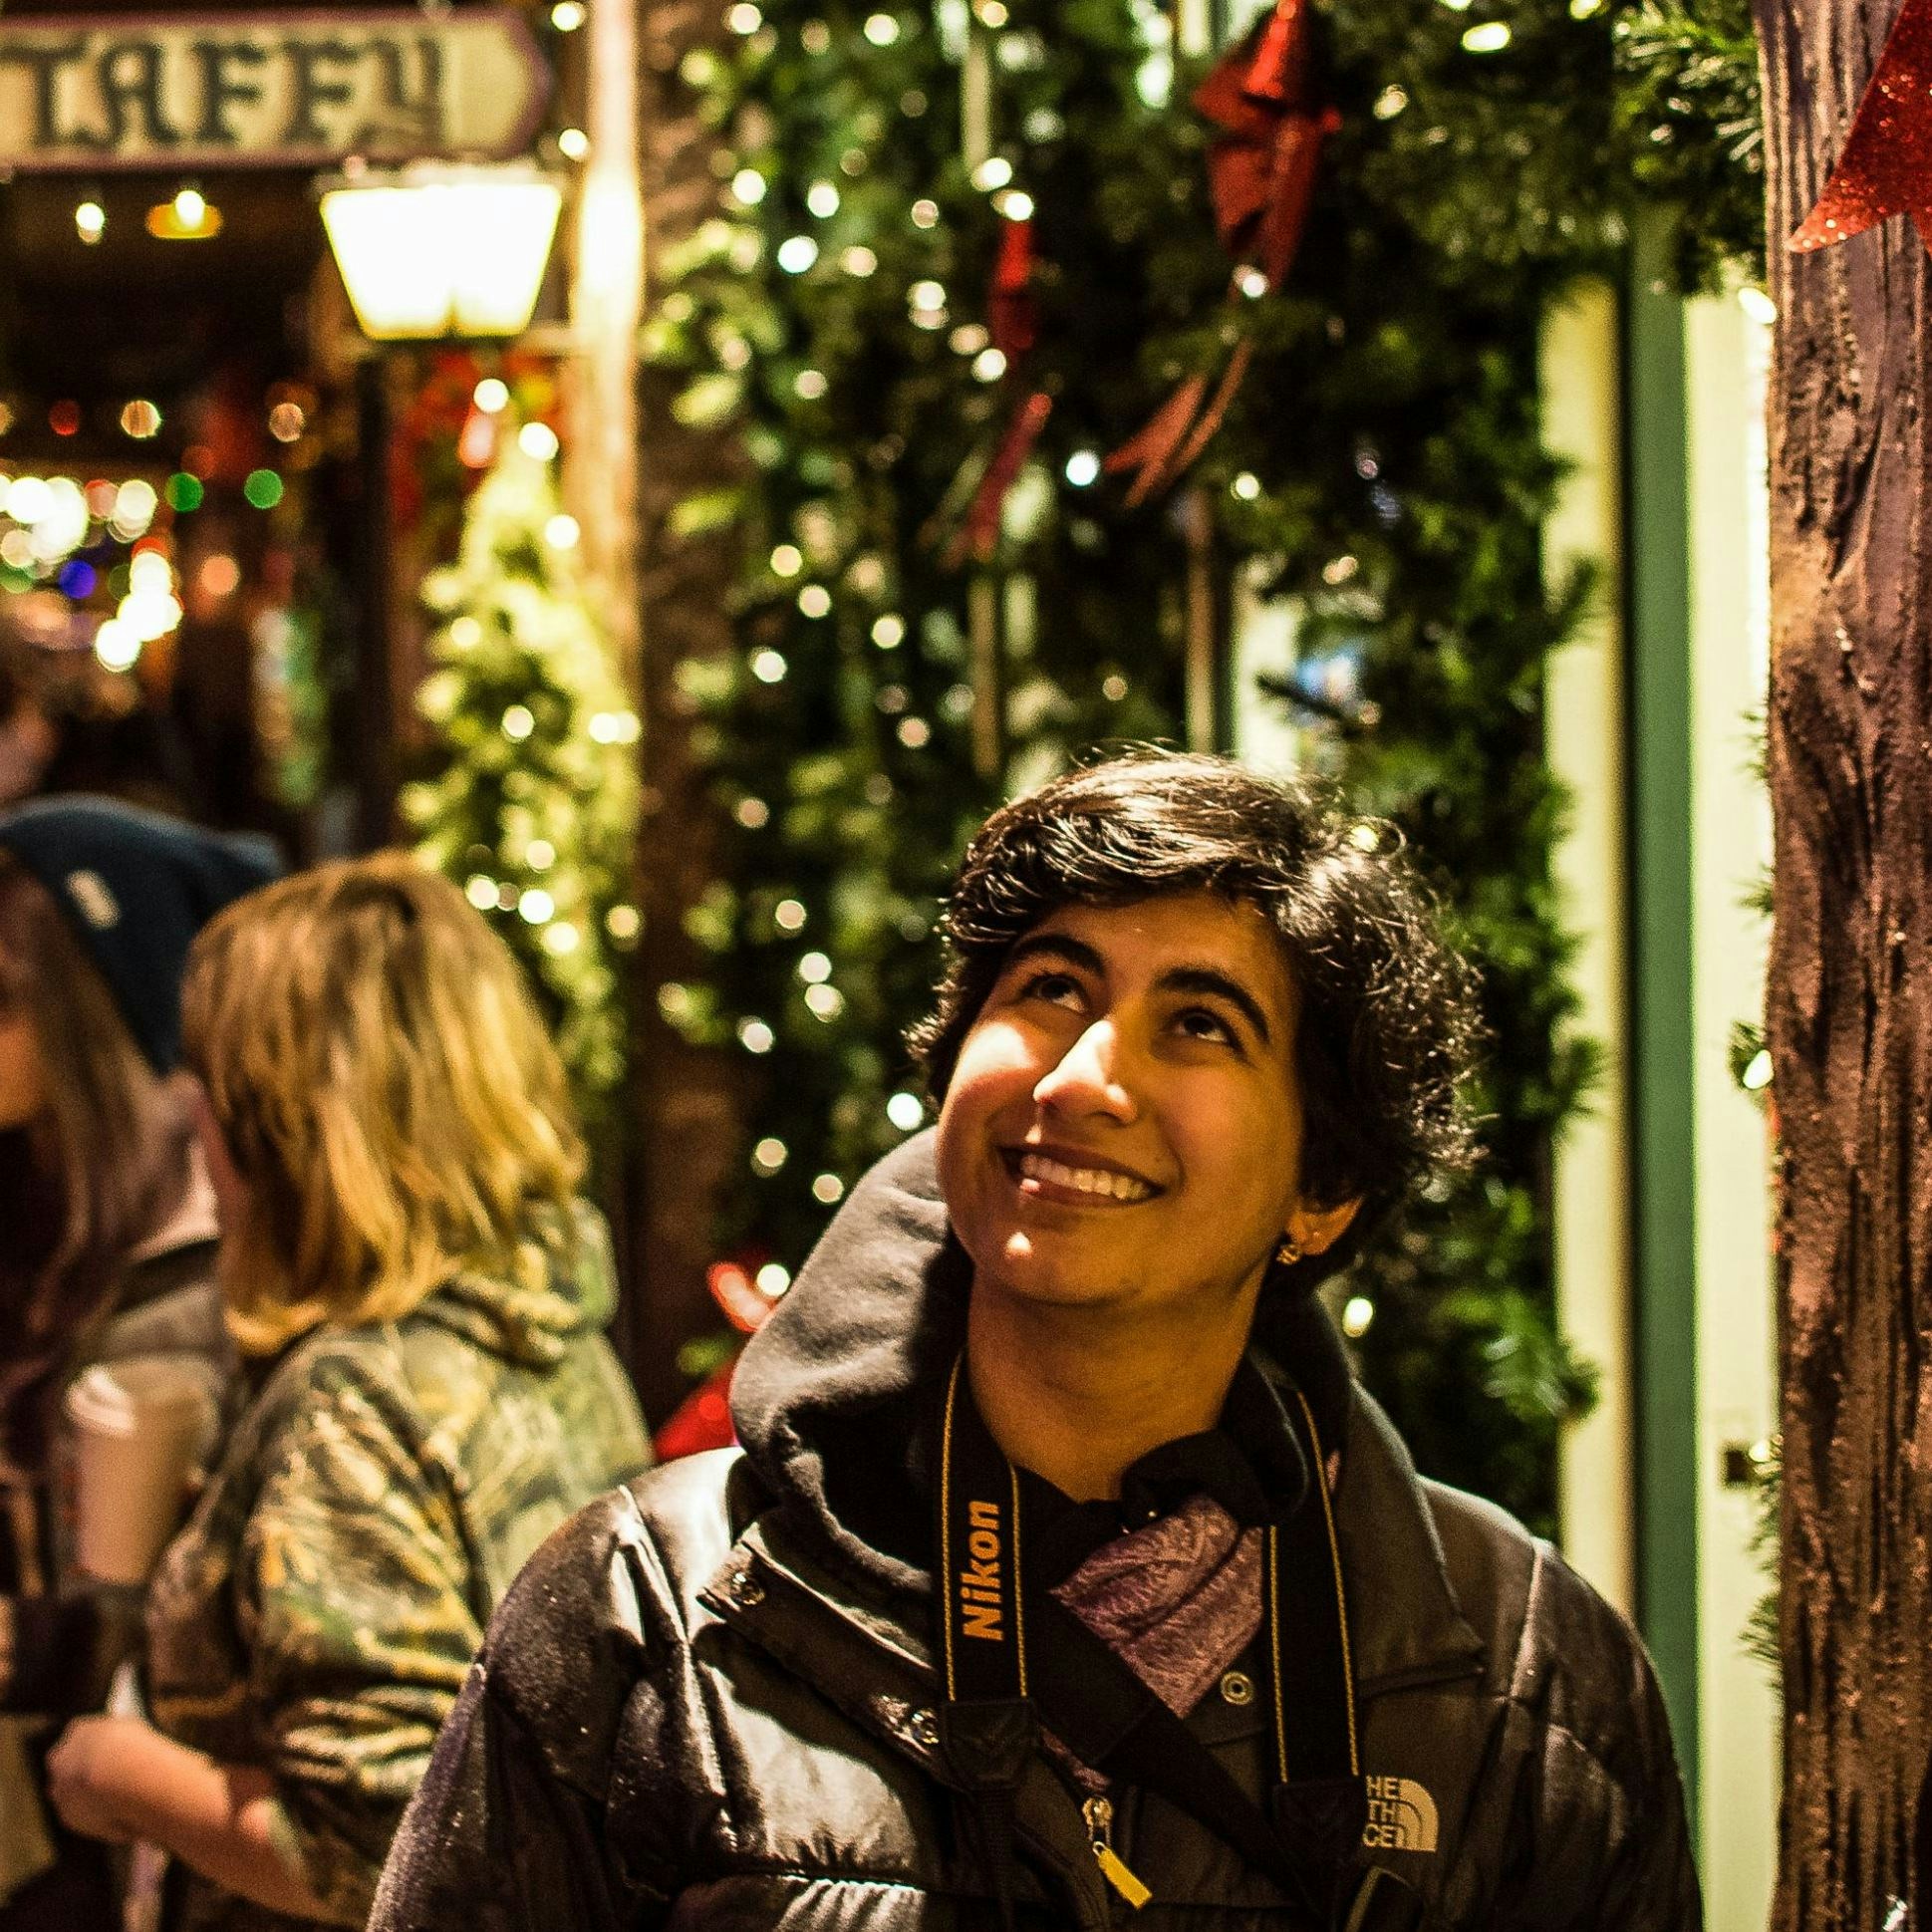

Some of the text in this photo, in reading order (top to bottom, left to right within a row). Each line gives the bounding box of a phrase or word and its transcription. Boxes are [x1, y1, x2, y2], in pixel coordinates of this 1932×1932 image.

[0, 38, 444, 146] TAFFY
[960, 1501, 1003, 1641] Nikon
[1366, 1776, 1399, 1799] HE
[1362, 1823, 1394, 1847] CE
